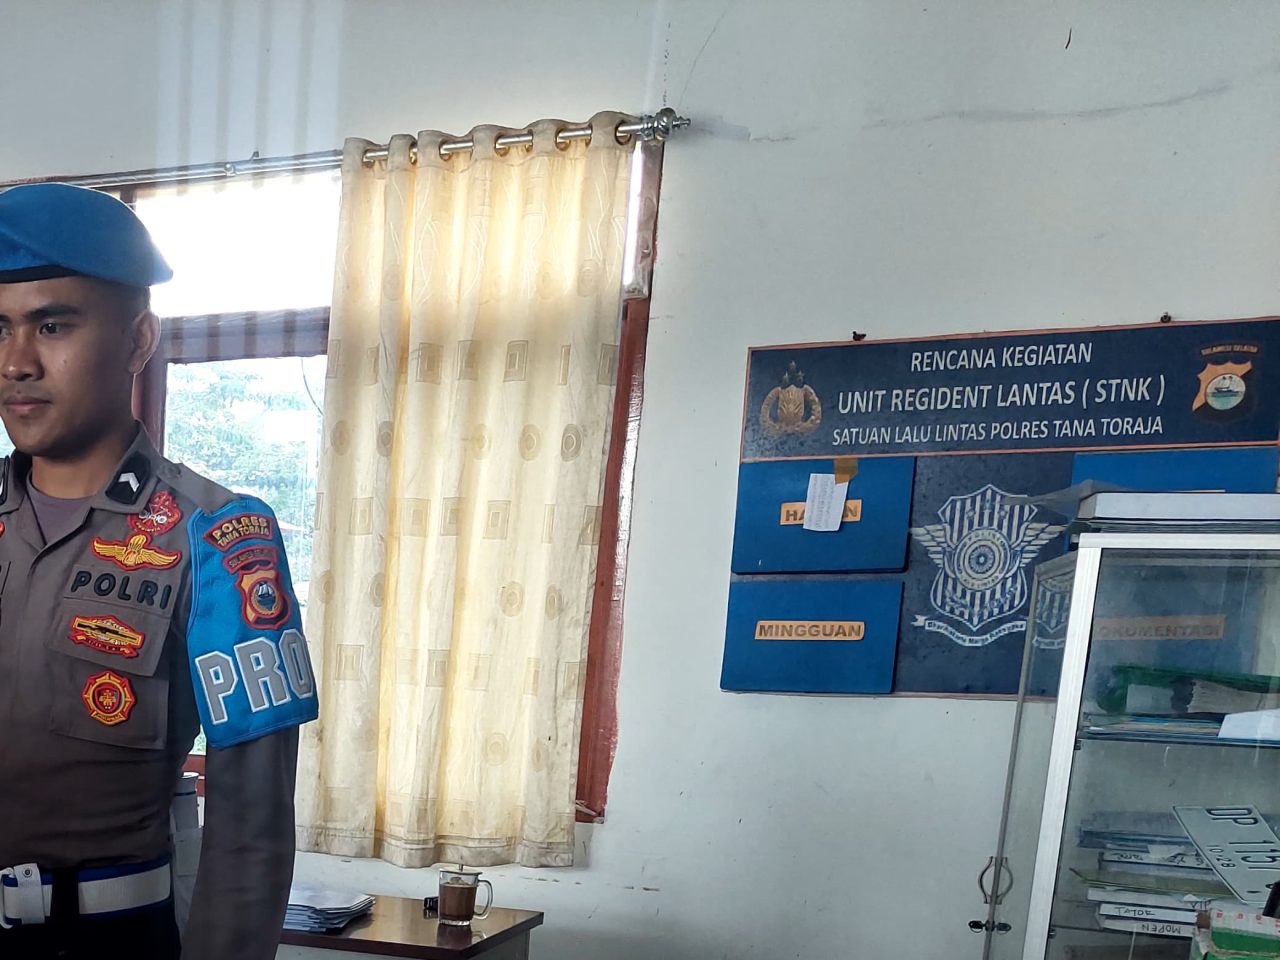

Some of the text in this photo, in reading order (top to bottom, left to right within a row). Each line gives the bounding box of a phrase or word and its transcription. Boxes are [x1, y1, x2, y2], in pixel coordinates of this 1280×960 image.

[910, 342, 1093, 372] RENCANA KEGIATAN
[837, 389, 887, 414] UNIT
[890, 384, 993, 412] REGIDENT
[996, 380, 1077, 407] LANTAS
[1094, 375, 1153, 404] STNK
[831, 415, 1164, 446] SATUAN LALU LINTAS POLRES TANA TORAJA
[212, 515, 268, 540] POLRES
[70, 570, 173, 610] POLRI
[758, 624, 862, 638] MINGGUAN
[1099, 623, 1220, 638] OKUMENTASI
